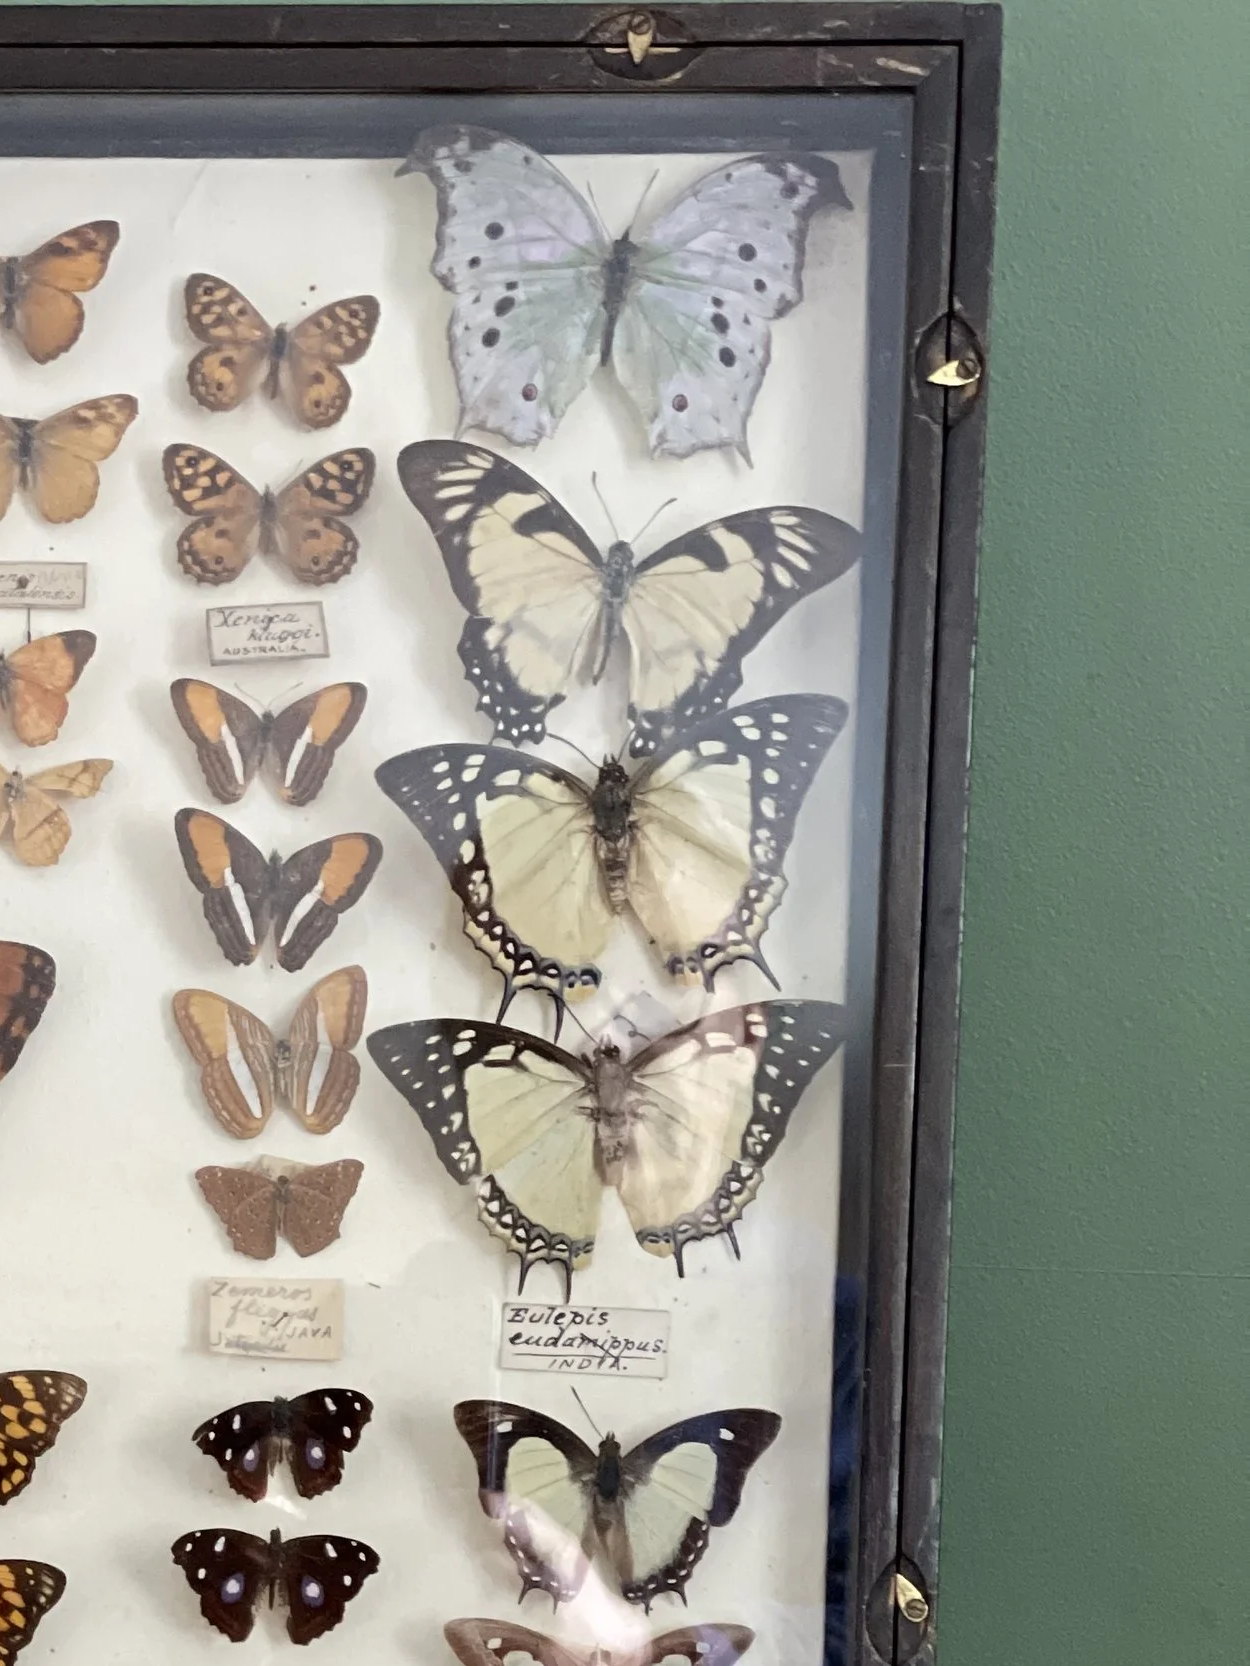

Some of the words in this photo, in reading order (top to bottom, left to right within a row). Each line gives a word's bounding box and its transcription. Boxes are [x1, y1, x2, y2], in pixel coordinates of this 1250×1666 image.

[508, 1306, 610, 1328] Eulepis
[286, 1326, 332, 1338] JAVA
[548, 1358, 628, 1371] INDIA.
